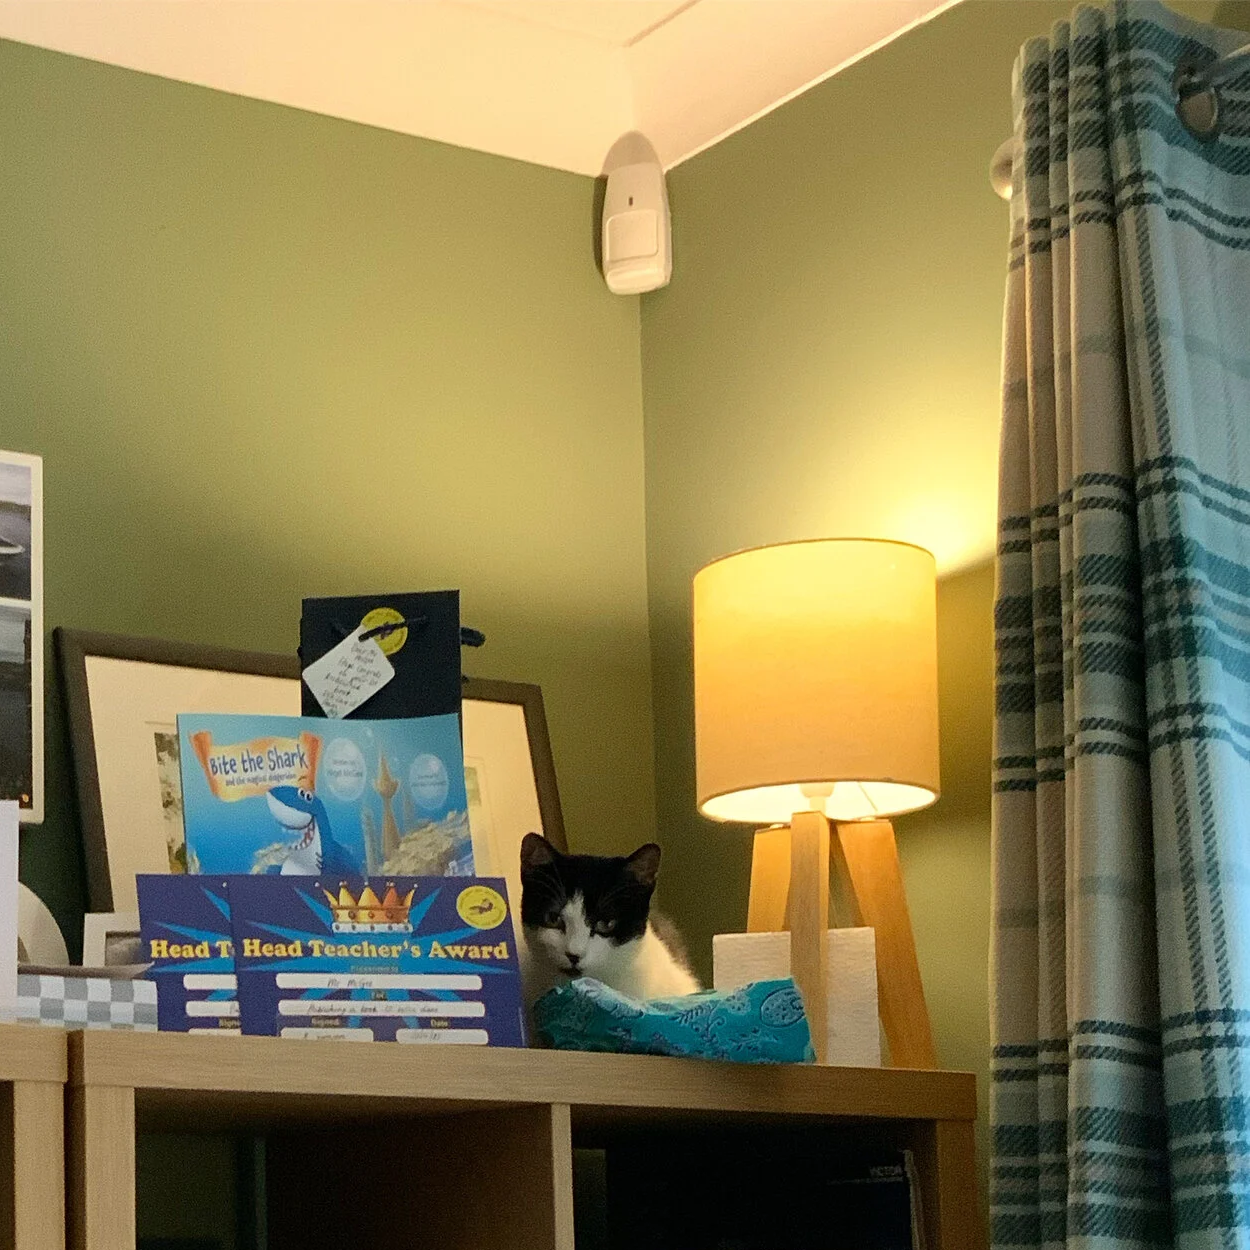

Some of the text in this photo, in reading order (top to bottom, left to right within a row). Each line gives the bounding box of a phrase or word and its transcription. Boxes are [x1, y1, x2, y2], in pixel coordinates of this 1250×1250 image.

[210, 744, 309, 777] Bite the Shark
[150, 938, 210, 958] Head
[243, 938, 510, 960] Head Teacher's Award
